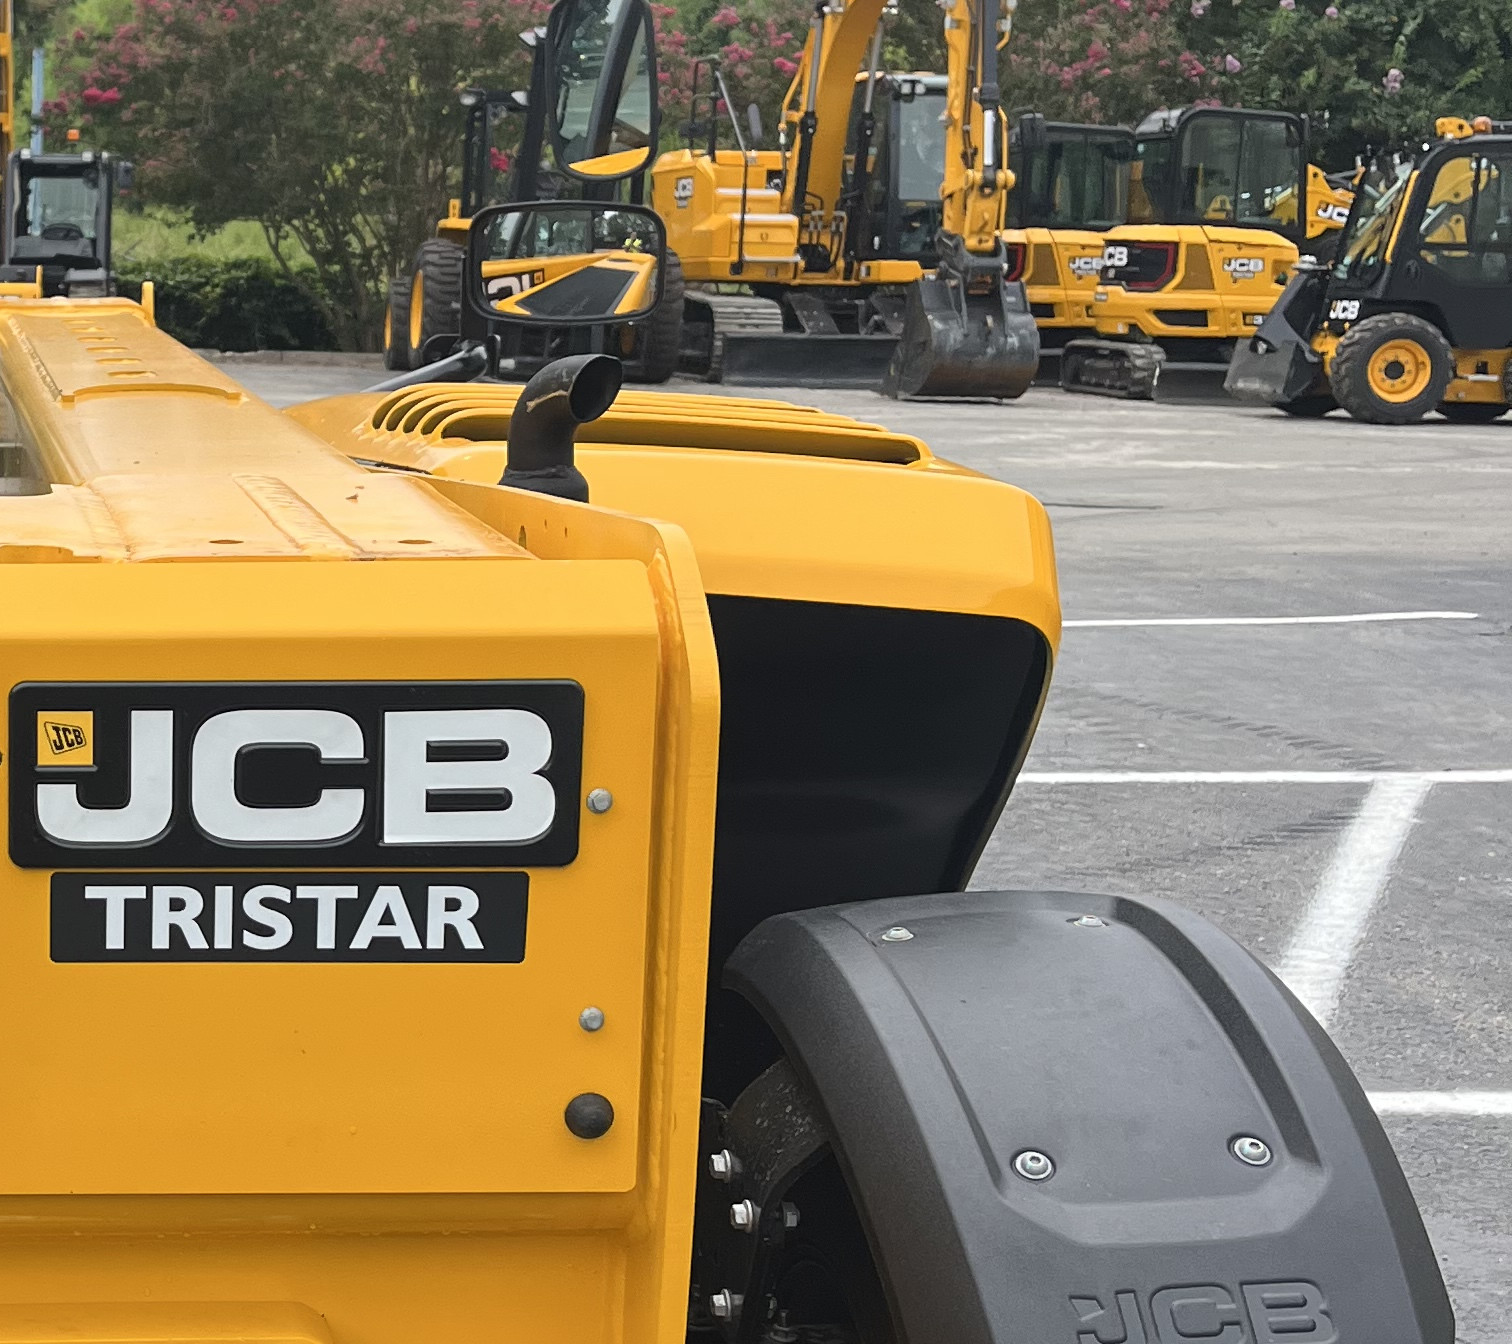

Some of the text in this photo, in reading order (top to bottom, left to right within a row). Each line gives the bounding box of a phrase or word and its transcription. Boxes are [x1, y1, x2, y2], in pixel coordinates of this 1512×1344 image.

[1317, 203, 1349, 224] JC
[1104, 246, 1128, 266] CB
[51, 726, 84, 750] JCB
[37, 709, 557, 844] JCB
[85, 885, 484, 950] TRISTAR
